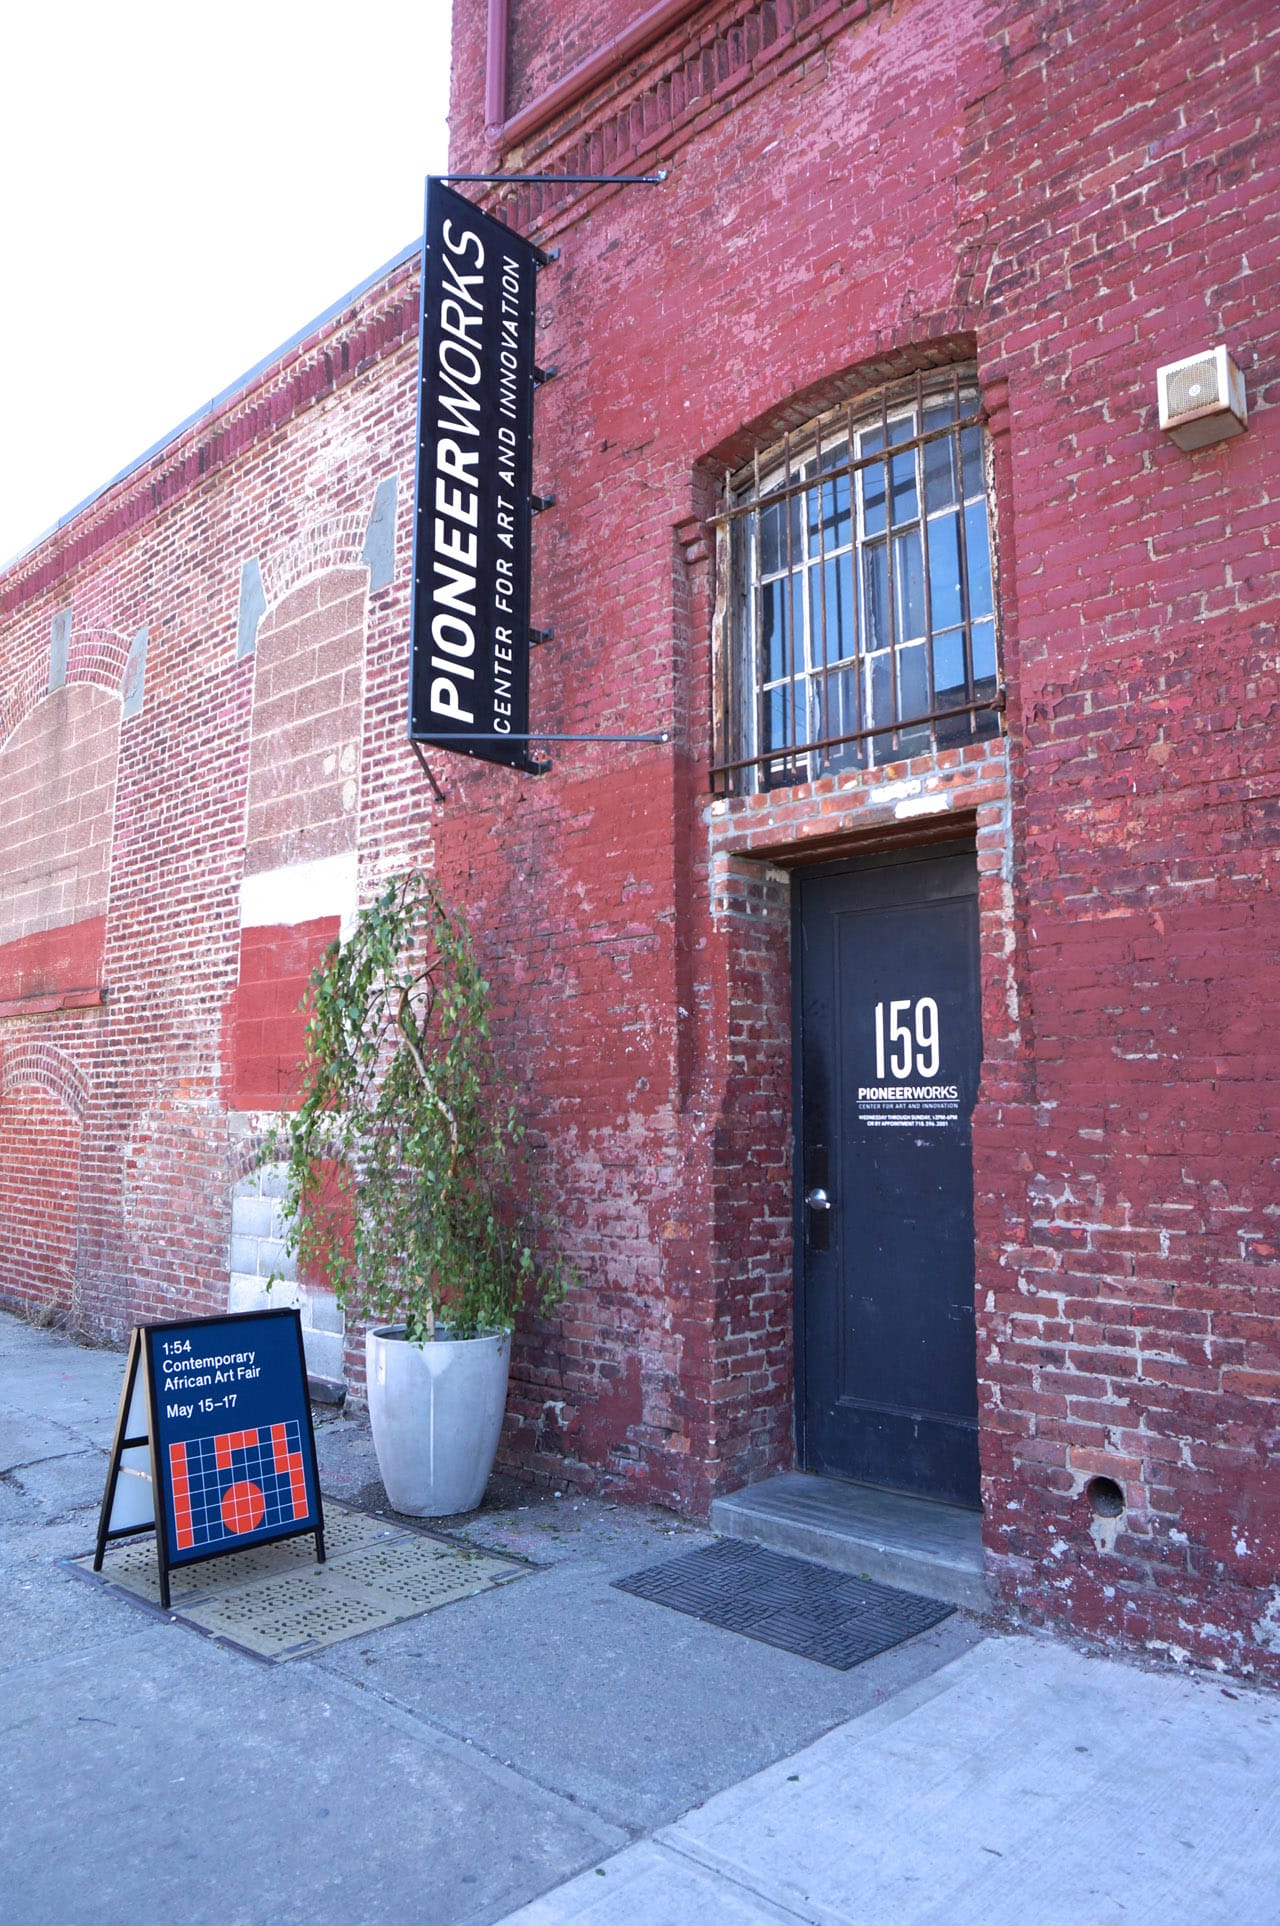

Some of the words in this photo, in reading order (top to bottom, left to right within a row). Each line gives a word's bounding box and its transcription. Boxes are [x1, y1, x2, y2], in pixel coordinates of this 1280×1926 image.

[498, 255, 521, 419] INNOVATION
[430, 218, 485, 724] PIONEERWORKS
[497, 427, 517, 487] AND
[496, 495, 515, 549] ART
[495, 558, 513, 613] FOR
[493, 625, 513, 734] CENTER
[875, 997, 940, 1079] 159
[858, 1085, 958, 1100] PIONEERWORKS
[162, 1339, 192, 1356] 1:54
[162, 1351, 256, 1374] Contemporary
[164, 1375, 212, 1392] African
[214, 1369, 235, 1385] Art
[237, 1365, 261, 1380] Fair
[166, 1403, 194, 1419] May
